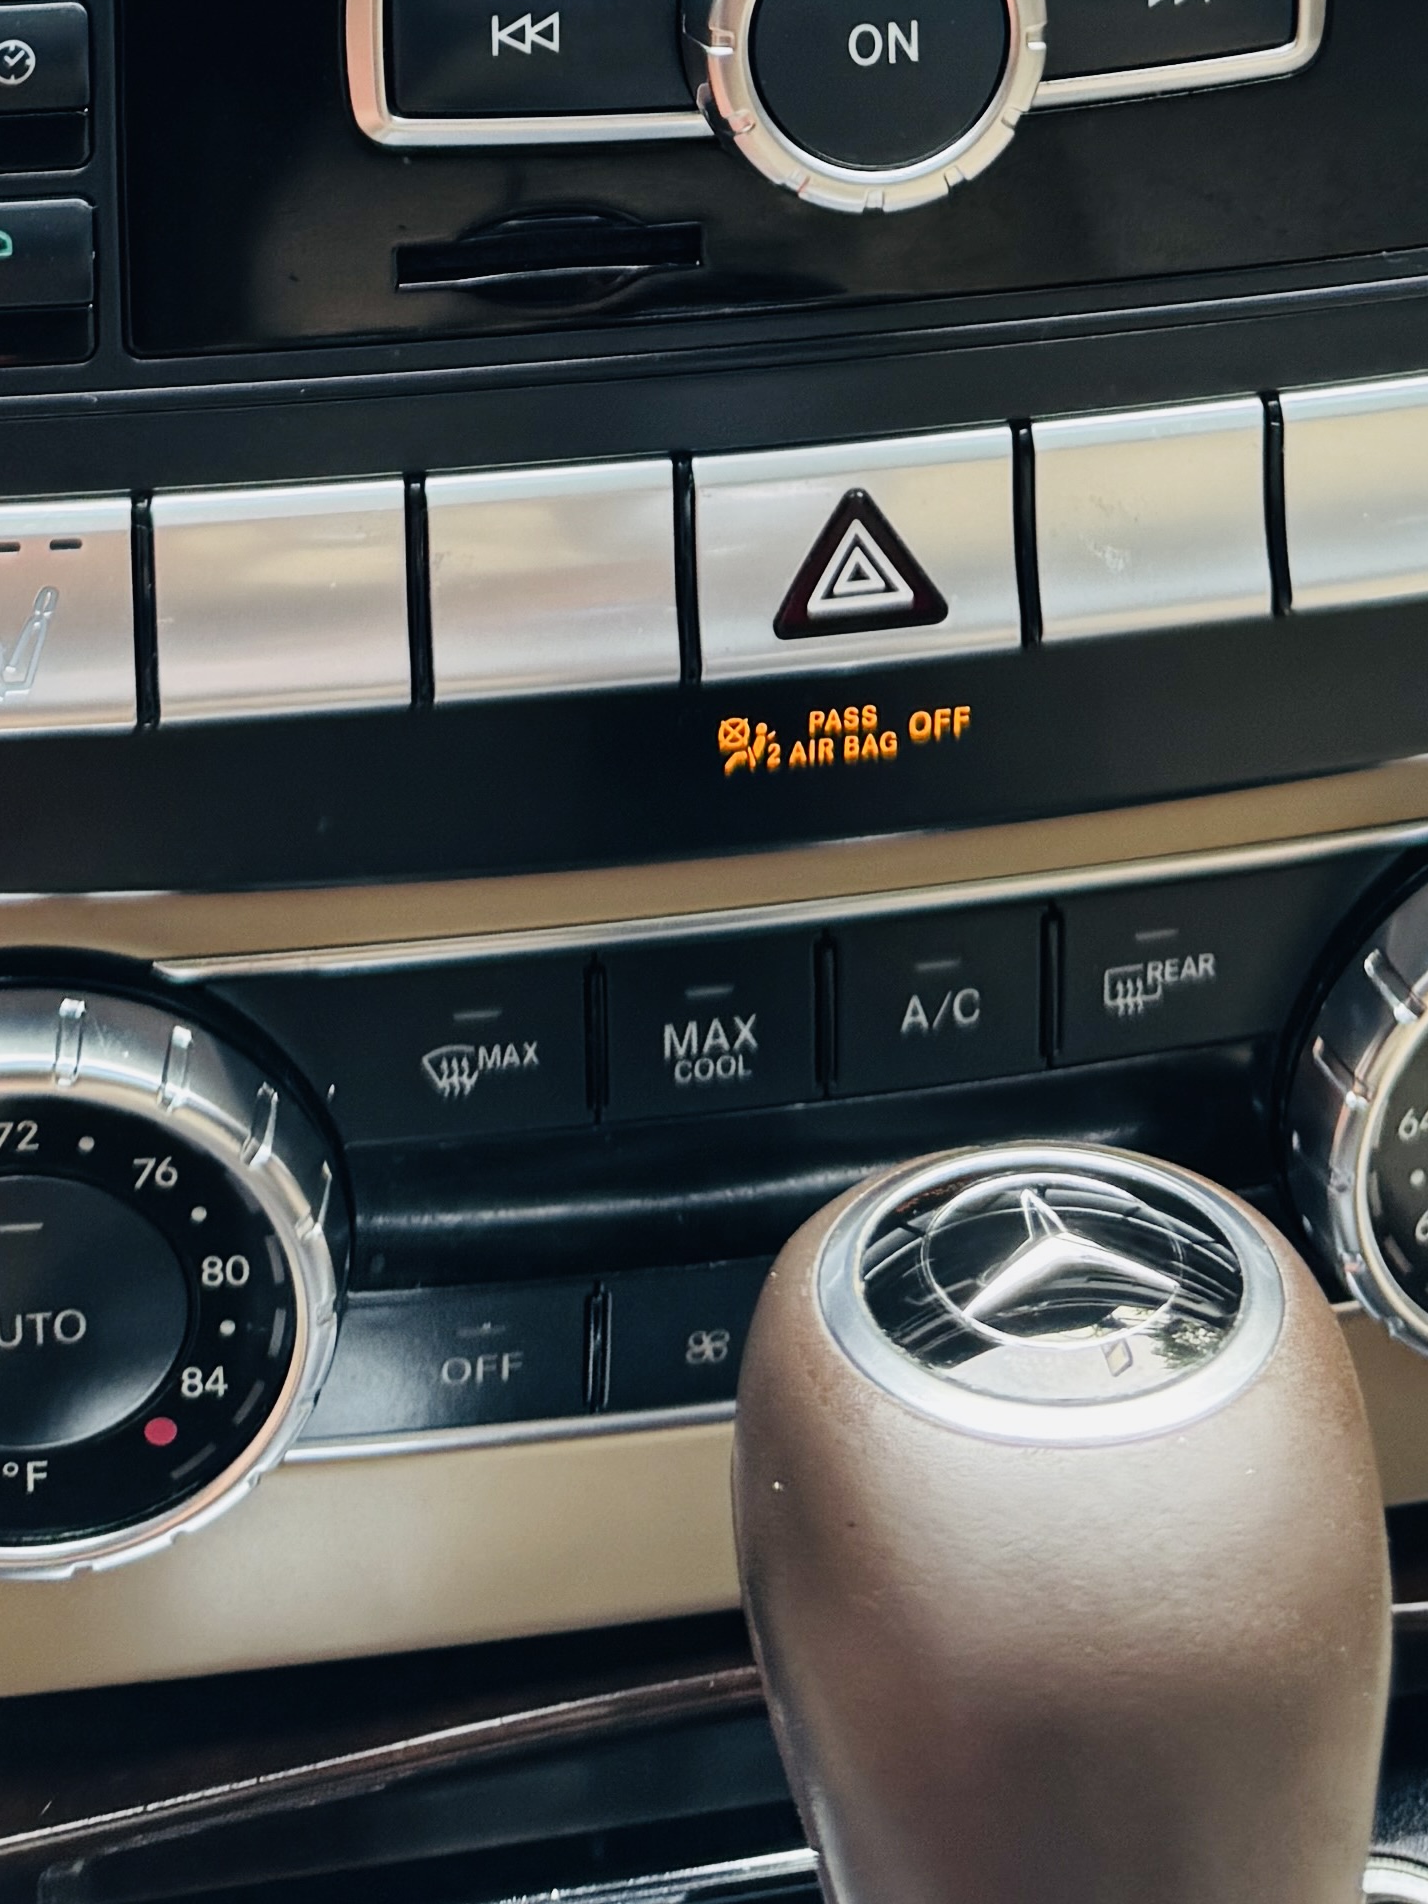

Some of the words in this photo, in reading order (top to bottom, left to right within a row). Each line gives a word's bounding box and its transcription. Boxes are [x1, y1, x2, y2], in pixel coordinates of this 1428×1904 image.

[849, 20, 918, 66] ON
[809, 705, 878, 734] PASS
[909, 706, 970, 740] OFF
[789, 741, 834, 766] AIR
[844, 731, 898, 761] BAG
[1147, 954, 1215, 984] REAR
[902, 989, 979, 1032] A/C
[664, 1014, 758, 1058] MAX
[478, 1042, 538, 1070] MAX
[675, 1056, 752, 1083] COOL
[134, 1157, 177, 1188] 76
[202, 1255, 249, 1286] 80
[181, 1366, 228, 1398] 84
[441, 1352, 522, 1386] OFF
